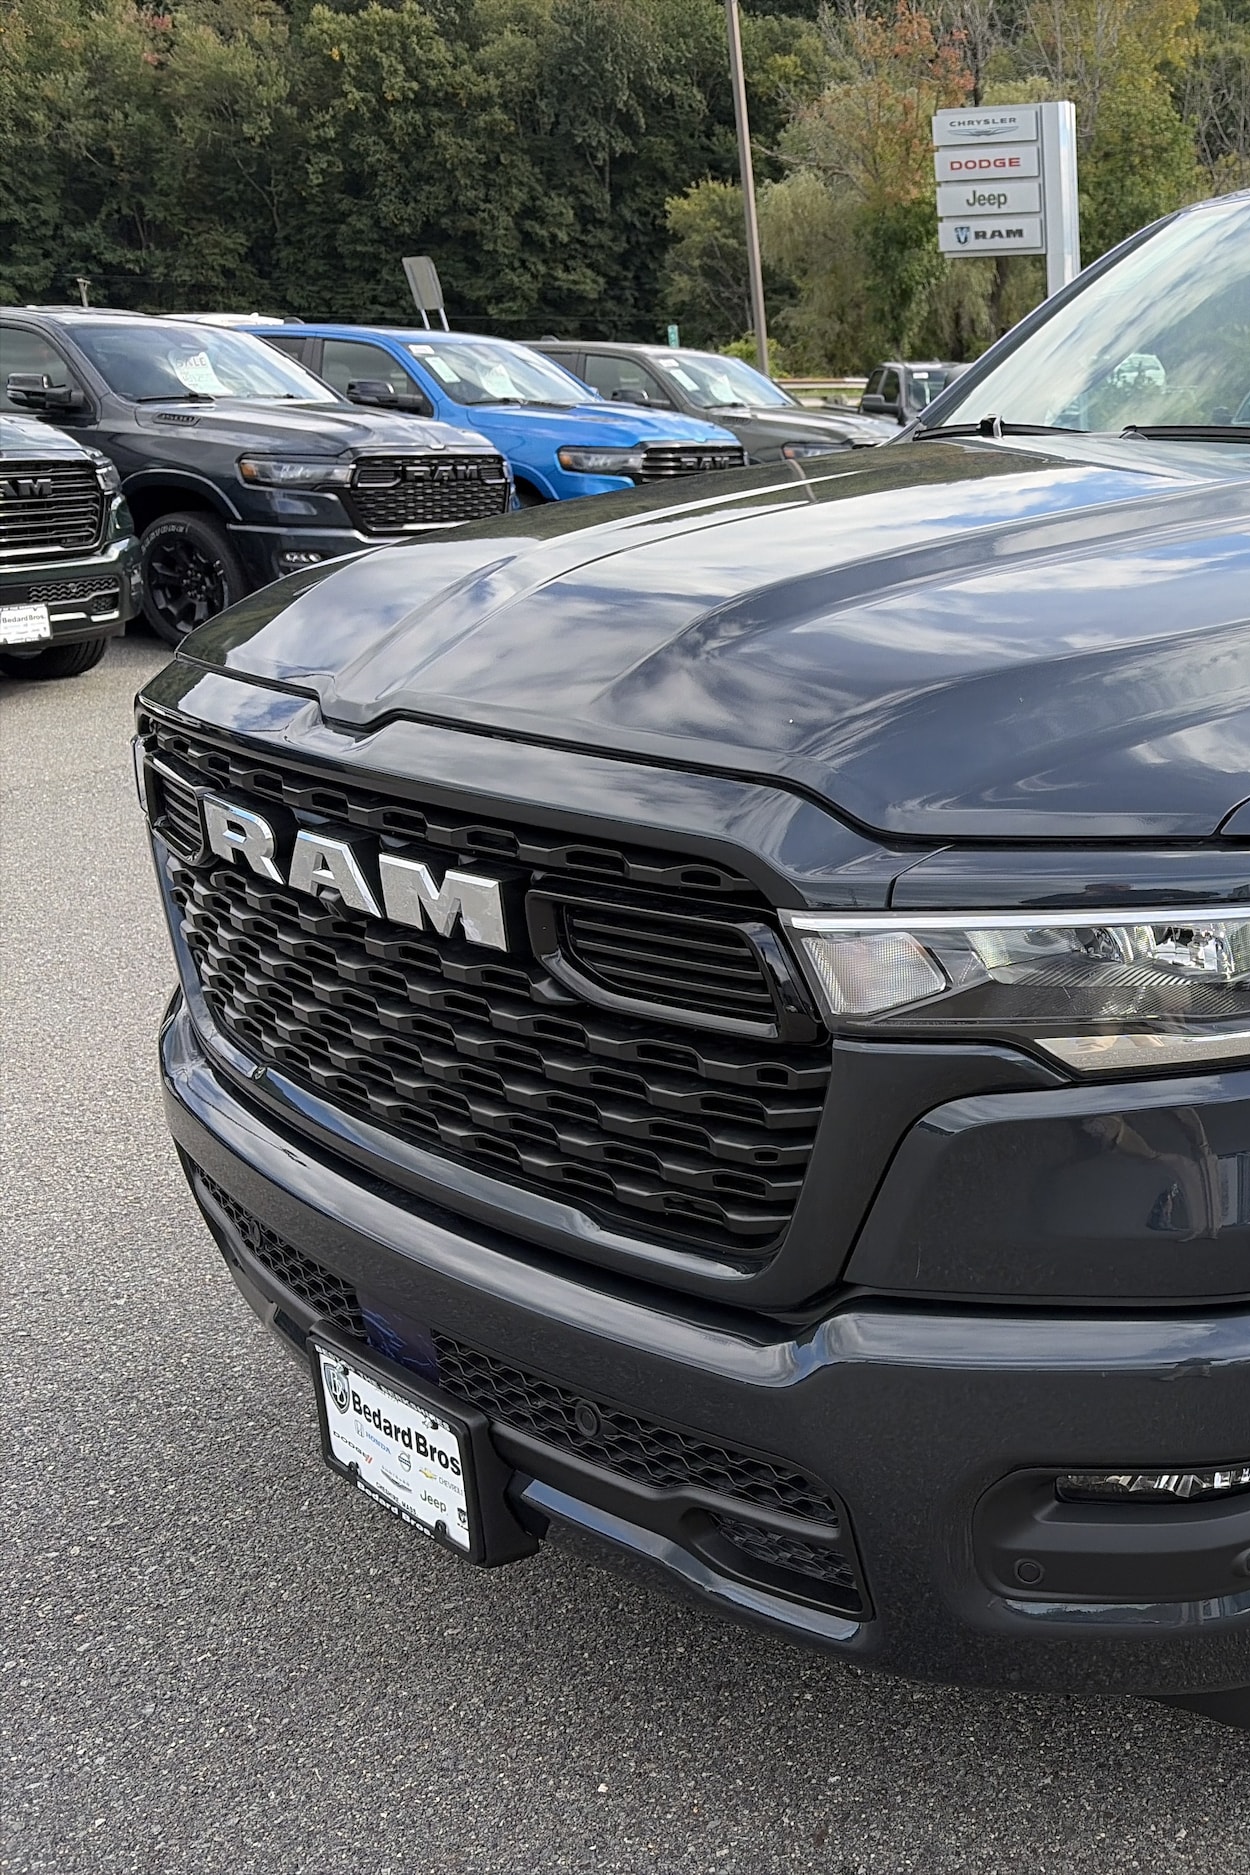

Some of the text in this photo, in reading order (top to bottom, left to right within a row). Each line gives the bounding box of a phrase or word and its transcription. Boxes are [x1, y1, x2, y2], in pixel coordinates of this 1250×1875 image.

[949, 117, 1017, 127] CHRYSLER
[950, 157, 1021, 171] DODGE
[966, 190, 1008, 208] Jeep
[974, 228, 1024, 240] RAM
[176, 356, 207, 368] SALE
[405, 465, 478, 481] RAM
[0, 479, 52, 497] AM
[2, 615, 28, 623] Bedard
[203, 793, 508, 953] RAM
[351, 1390, 413, 1450] Bedard
[333, 1430, 370, 1462] DODGE
[365, 1431, 391, 1455] HONDA
[356, 1480, 399, 1516] Bedard
[419, 1489, 447, 1513] Jeep
